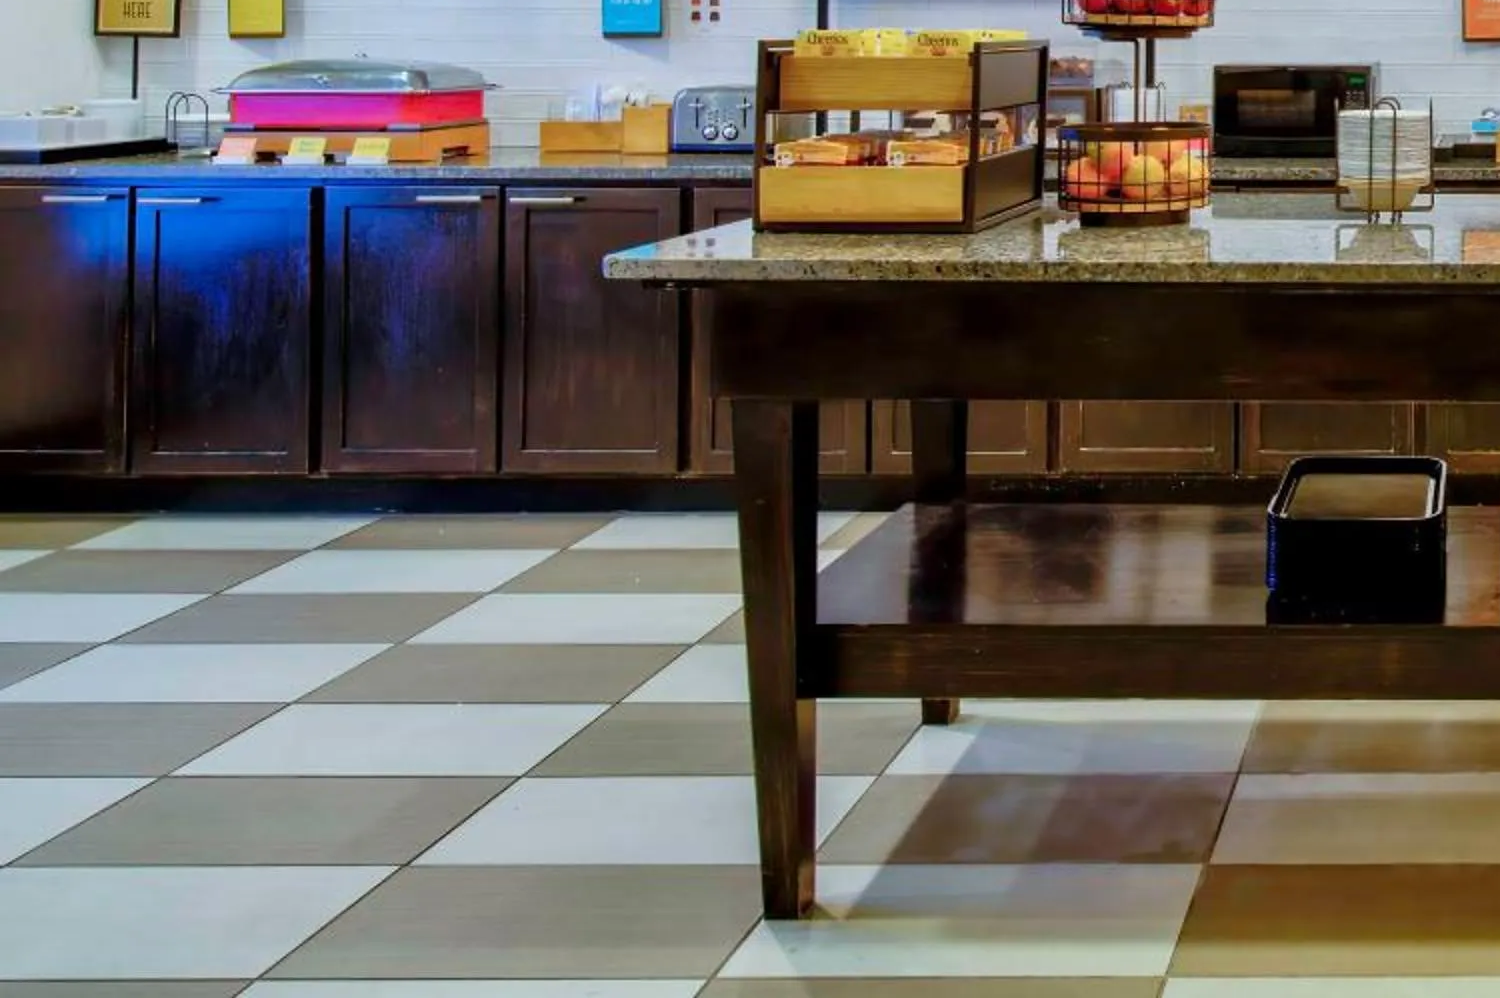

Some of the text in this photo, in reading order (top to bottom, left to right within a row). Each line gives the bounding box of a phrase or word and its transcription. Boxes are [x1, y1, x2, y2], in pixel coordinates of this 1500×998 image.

[123, 1, 152, 19] HERE
[807, 31, 849, 45] Cheerios
[917, 33, 959, 46] Cheerios
